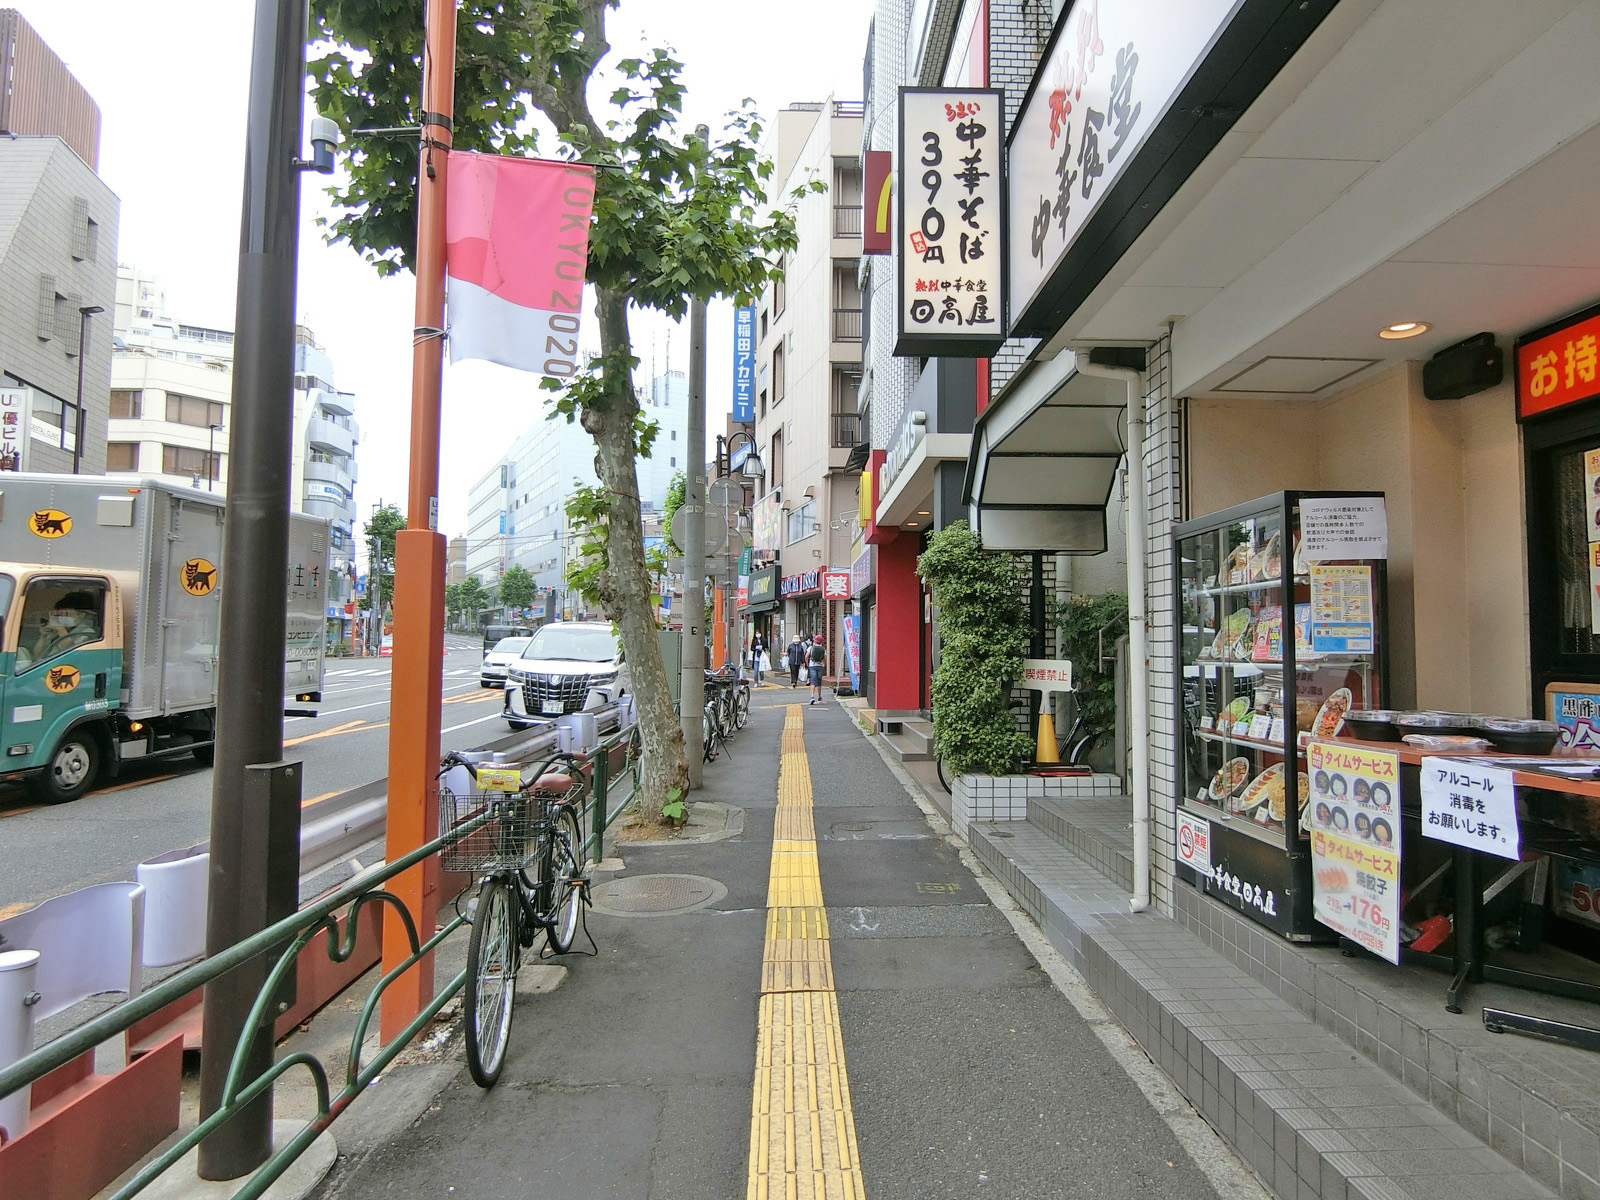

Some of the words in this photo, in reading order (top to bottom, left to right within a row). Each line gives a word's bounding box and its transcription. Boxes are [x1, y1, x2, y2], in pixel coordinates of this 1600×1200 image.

[944, 101, 981, 122] うまい
[1031, 42, 1142, 270] 中華食堂
[921, 131, 945, 264] 390円
[953, 118, 990, 264] 中華そば
[554, 168, 597, 282] TOKYO
[915, 277, 988, 293] 熱烈中華食堂
[910, 294, 995, 326] 日高屋
[543, 289, 582, 378] 2020
[737, 310, 751, 418] 早稲田アカデミー
[1530, 334, 1598, 398] お持
[288, 590, 318, 600] サービス
[826, 574, 848, 597] 薬
[1325, 750, 1394, 777] タイムサービス
[1437, 769, 1494, 793] アルコール
[1449, 792, 1486, 815] 消毒を
[1428, 810, 1507, 844] お願いします。
[1328, 839, 1394, 876] タイムサービス
[1351, 895, 1391, 931] 176円
